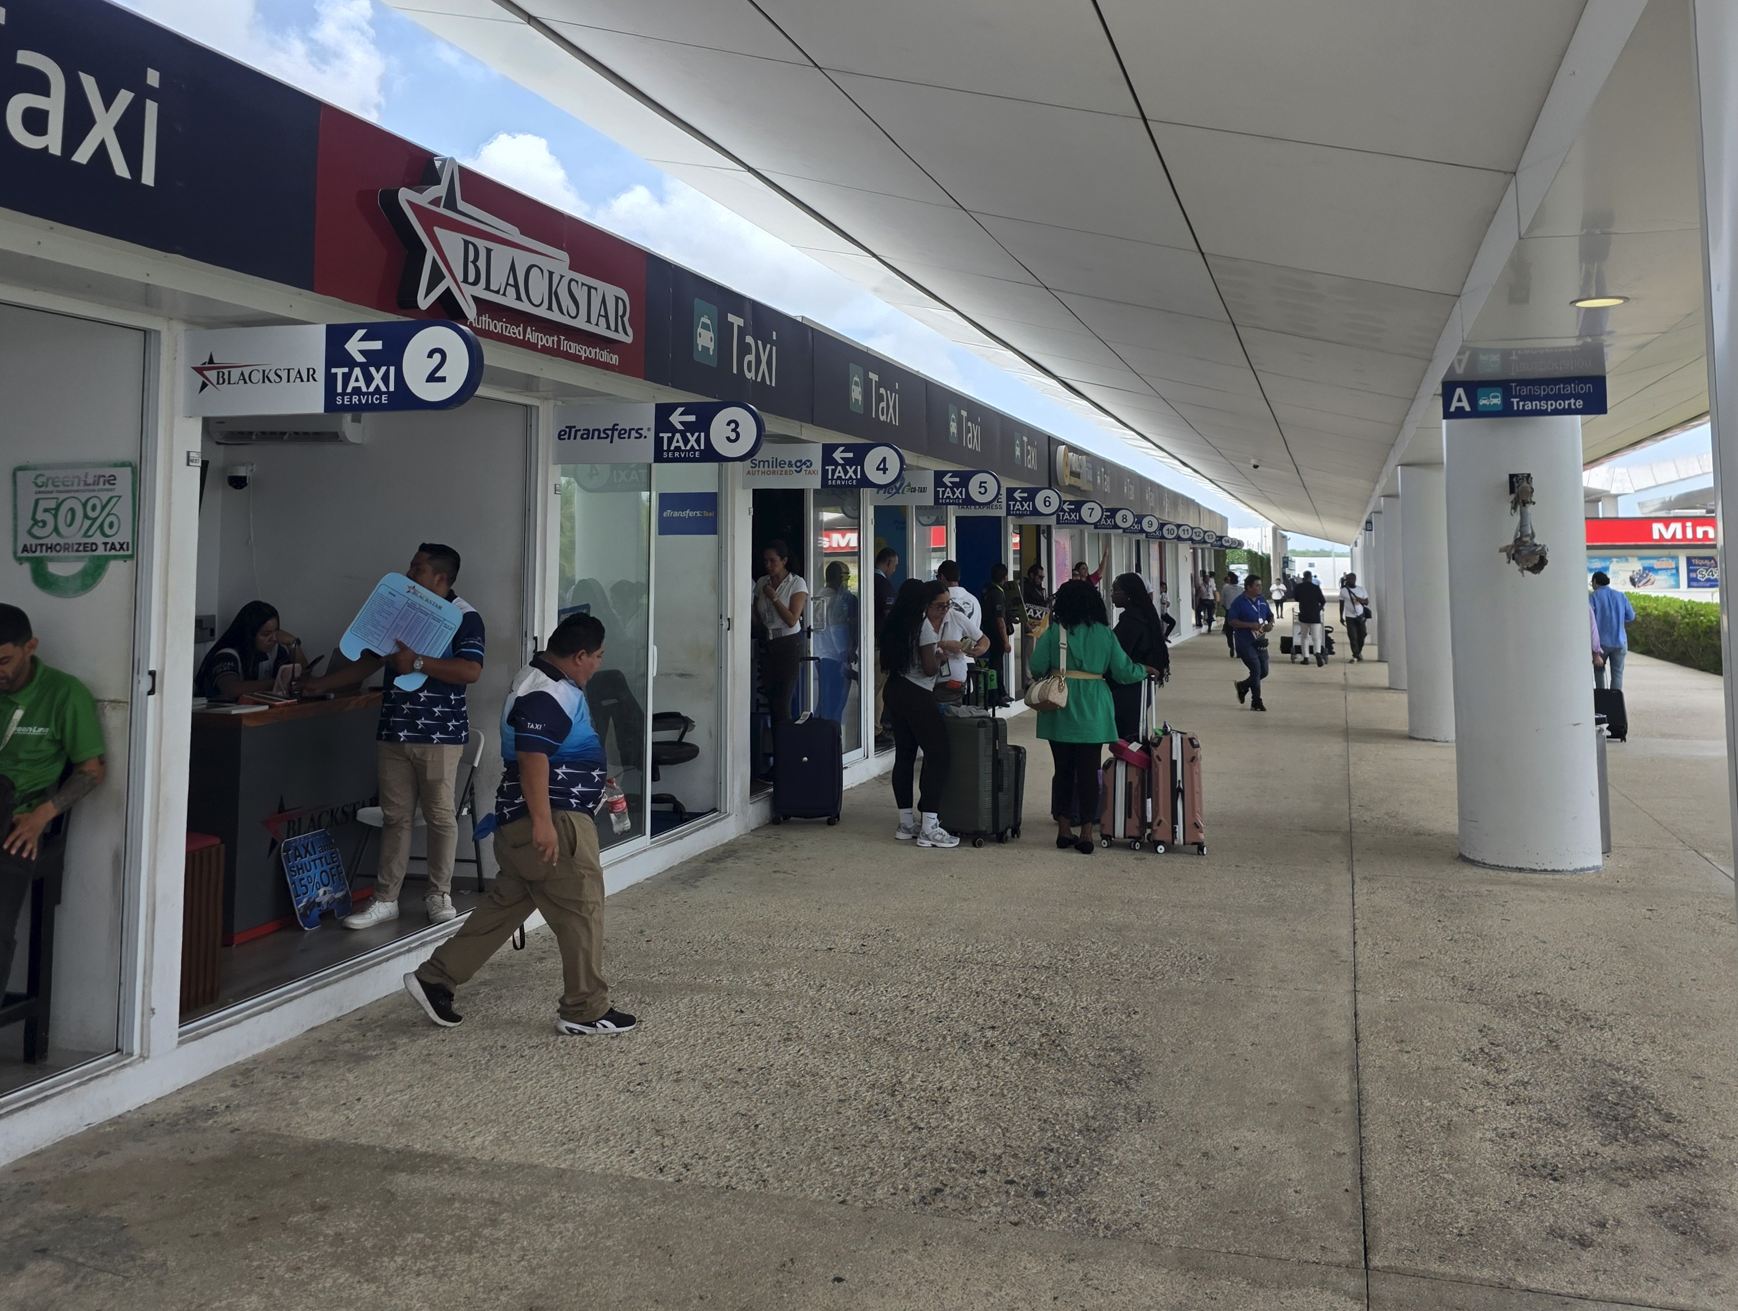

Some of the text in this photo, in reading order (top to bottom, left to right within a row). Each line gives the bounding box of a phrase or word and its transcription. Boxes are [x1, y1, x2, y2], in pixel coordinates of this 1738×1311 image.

[0, 6, 160, 187] axi
[460, 237, 631, 338] BLACKSTAR
[467, 314, 619, 366] Authorized Airport Transportation
[727, 312, 777, 387] Taxi
[425, 347, 448, 383] 2
[216, 367, 319, 386] BLACKSTAR
[331, 366, 395, 393] TAXI
[868, 371, 900, 426] Taxi
[1510, 381, 1593, 397] Transportation
[336, 394, 389, 405] SERVICE
[1450, 387, 1472, 412] A
[1511, 398, 1584, 412] Transporte
[725, 419, 741, 443] 3
[960, 409, 981, 452] Taxi
[659, 432, 705, 451] TAXI
[1022, 435, 1038, 470] Taxi
[825, 465, 861, 479] TAXI
[875, 456, 889, 475] 4
[937, 487, 966, 499] TAXI
[978, 480, 989, 495] 5
[1008, 502, 1033, 511] TAXI
[1043, 496, 1052, 508] 6
[27, 495, 123, 540] 50%
[1058, 512, 1080, 521] TAXI
[1087, 507, 1095, 518] 7
[1121, 514, 1128, 523] 8
[1147, 519, 1154, 528] 9
[1165, 527, 1175, 536] 10
[1182, 528, 1190, 536] 11
[21, 541, 130, 554] AUTHORIZED TAXI
[527, 722, 543, 731] TAXI
[287, 840, 317, 864] TAXI
[289, 852, 339, 878] SHUTTLE
